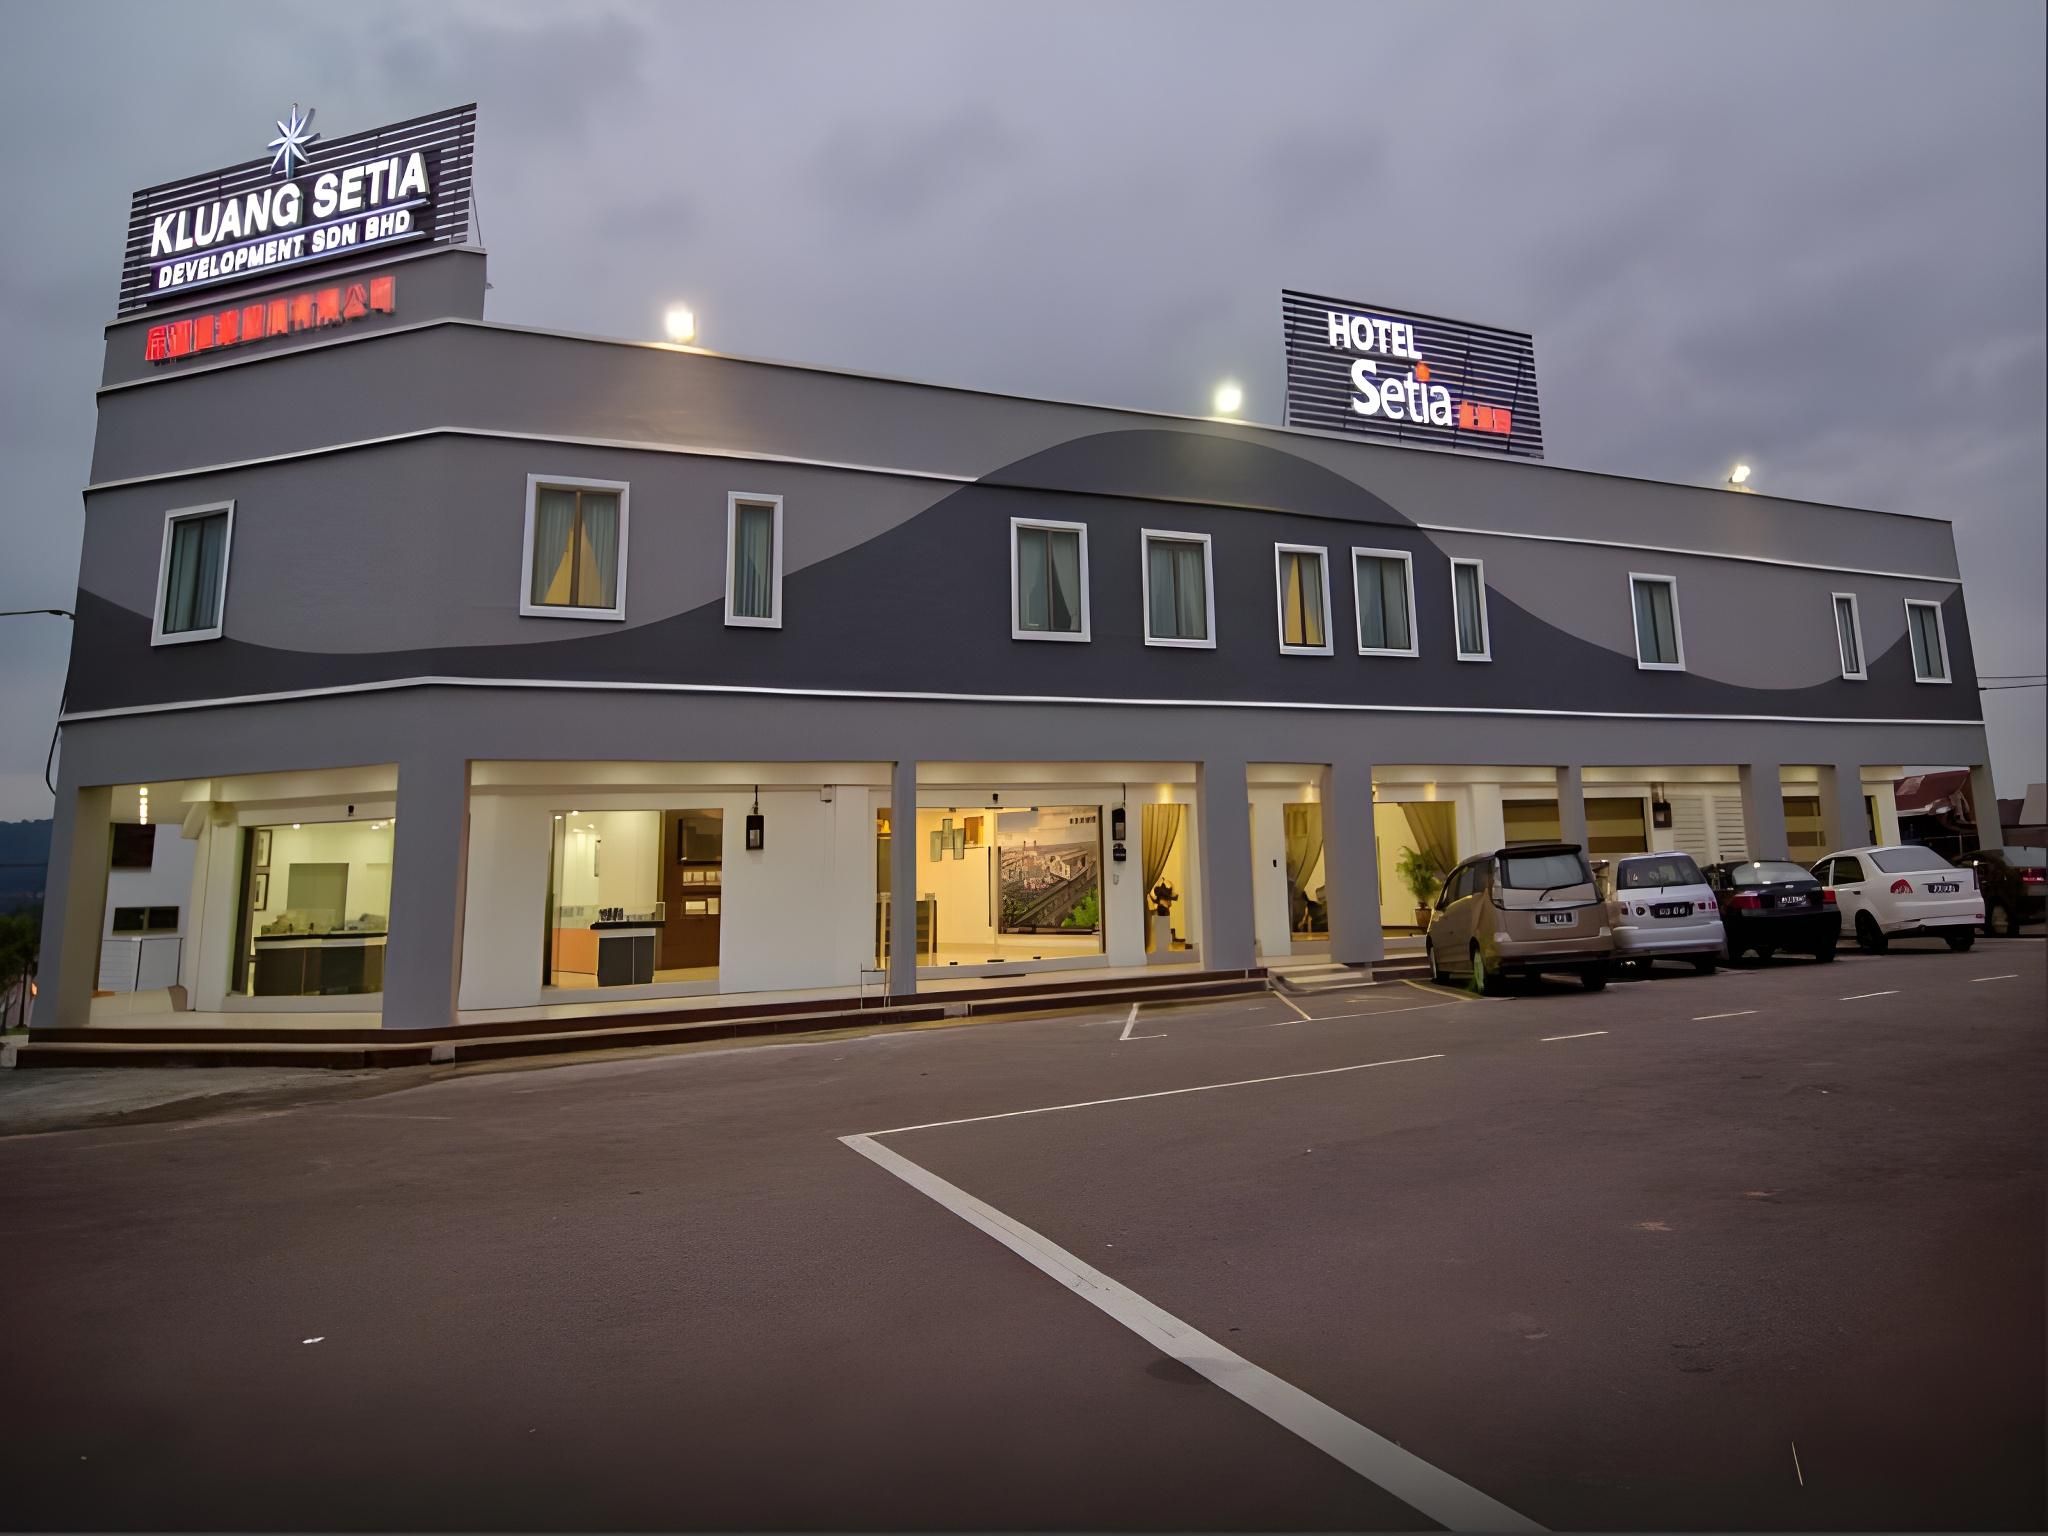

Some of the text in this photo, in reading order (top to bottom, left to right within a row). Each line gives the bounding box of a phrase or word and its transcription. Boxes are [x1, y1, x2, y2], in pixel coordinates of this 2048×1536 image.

[150, 152, 428, 257] KLUANG SETIA
[158, 211, 411, 289] DEVELOPMENT SDN BHD
[1328, 311, 1422, 359] HOTEL
[1351, 359, 1452, 426] Setia
